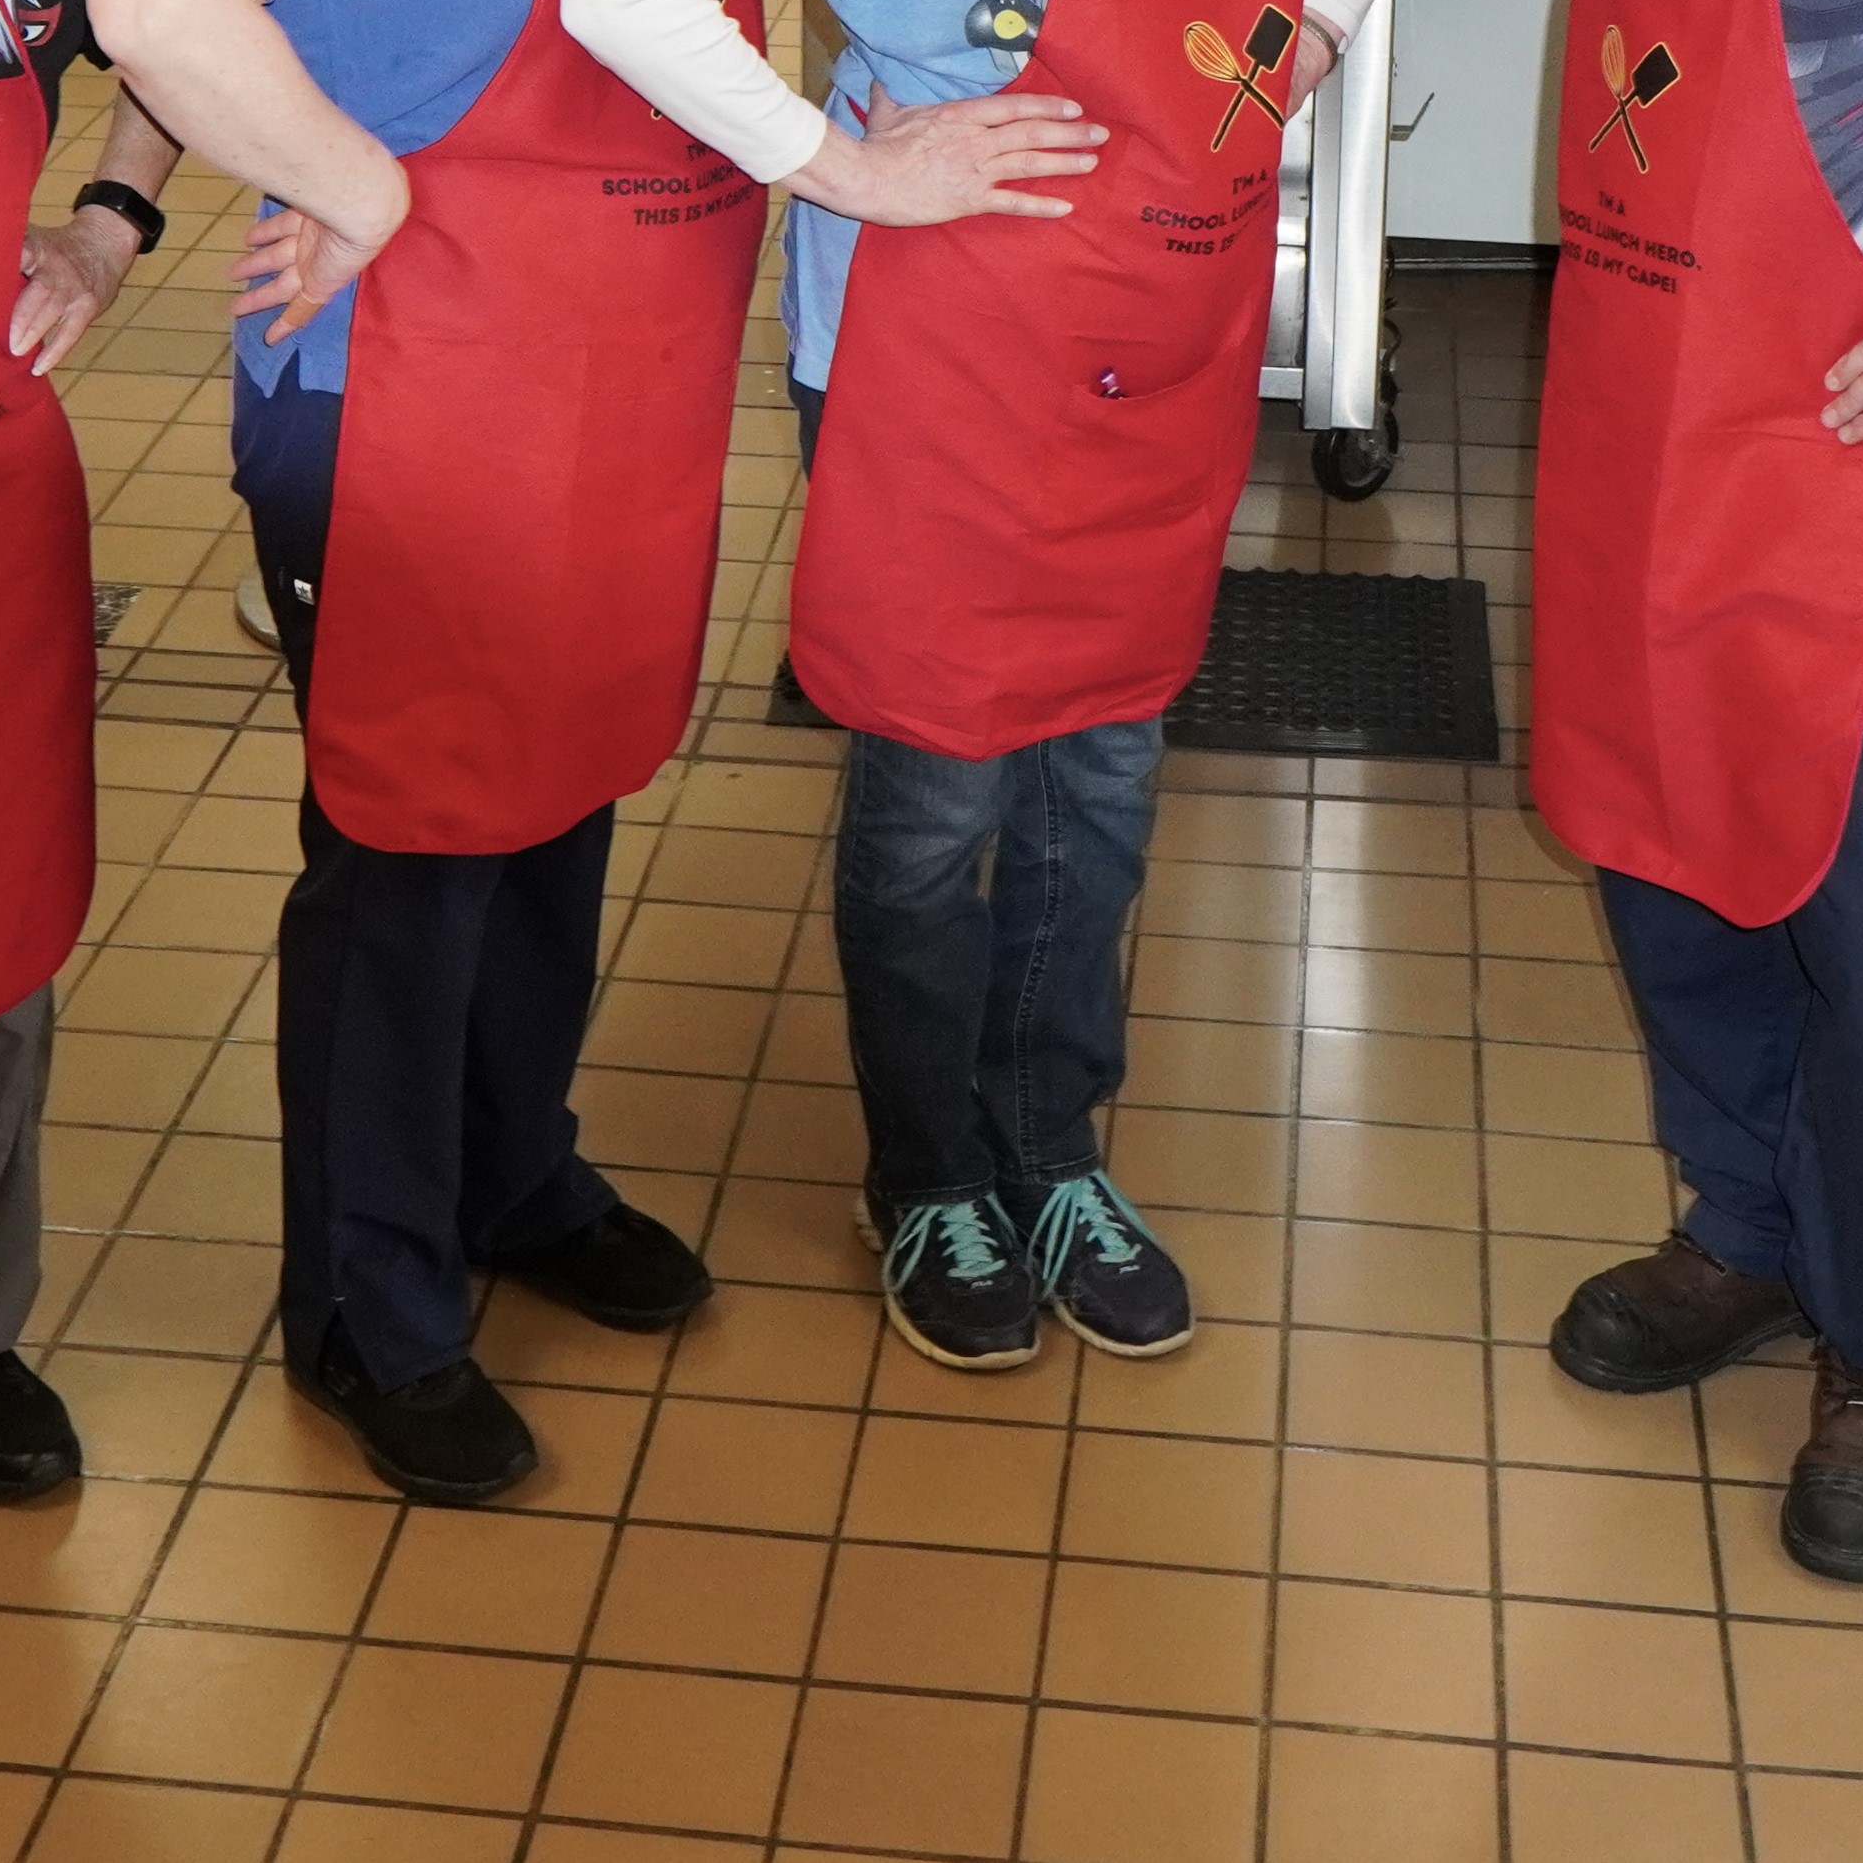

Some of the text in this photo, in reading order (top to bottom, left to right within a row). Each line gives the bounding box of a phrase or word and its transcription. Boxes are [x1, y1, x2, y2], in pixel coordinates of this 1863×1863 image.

[602, 163, 735, 196] SCHOOL LUNCH
[633, 207, 681, 225] THIS
[684, 203, 702, 222] IS
[704, 198, 722, 217] MY
[1141, 205, 1228, 230] SCHOOL
[1165, 238, 1215, 255] THIS
[1596, 220, 1640, 253] LUNCH
[1644, 239, 1703, 271] HERO.
[1561, 239, 1678, 294] HIS IS MY CAPE!
